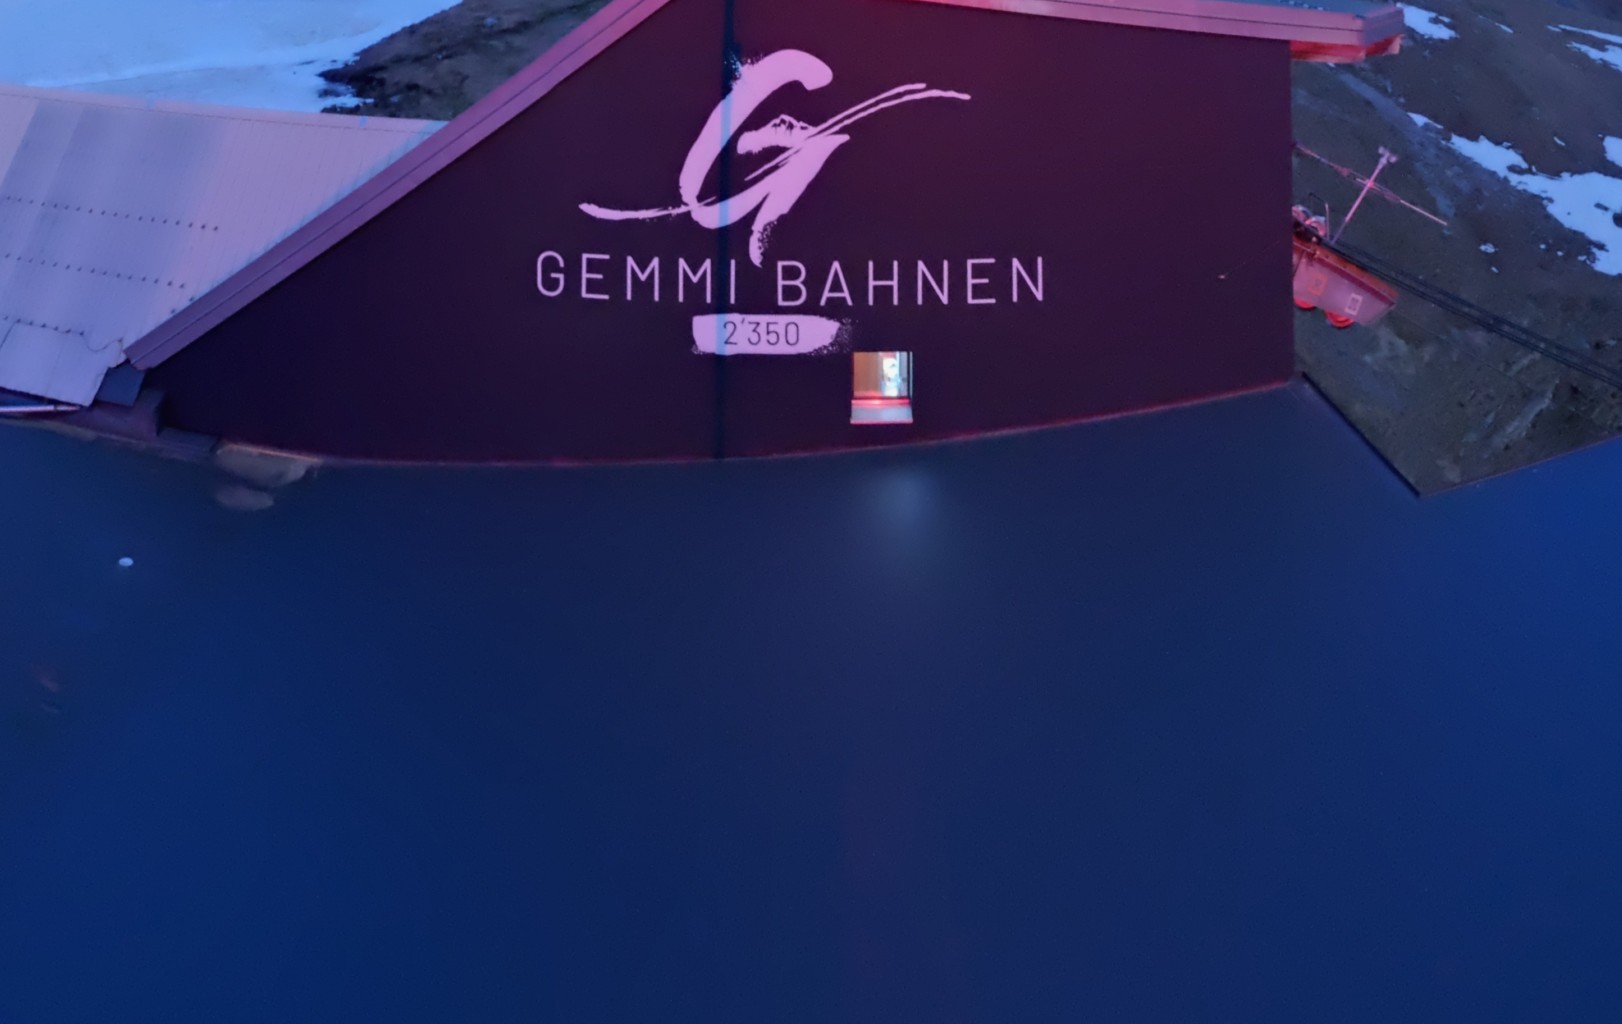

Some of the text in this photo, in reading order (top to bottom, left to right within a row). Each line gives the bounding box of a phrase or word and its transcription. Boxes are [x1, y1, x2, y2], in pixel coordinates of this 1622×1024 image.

[537, 251, 1044, 306] GEMMI BAHNEN
[723, 317, 800, 346] 2'350
